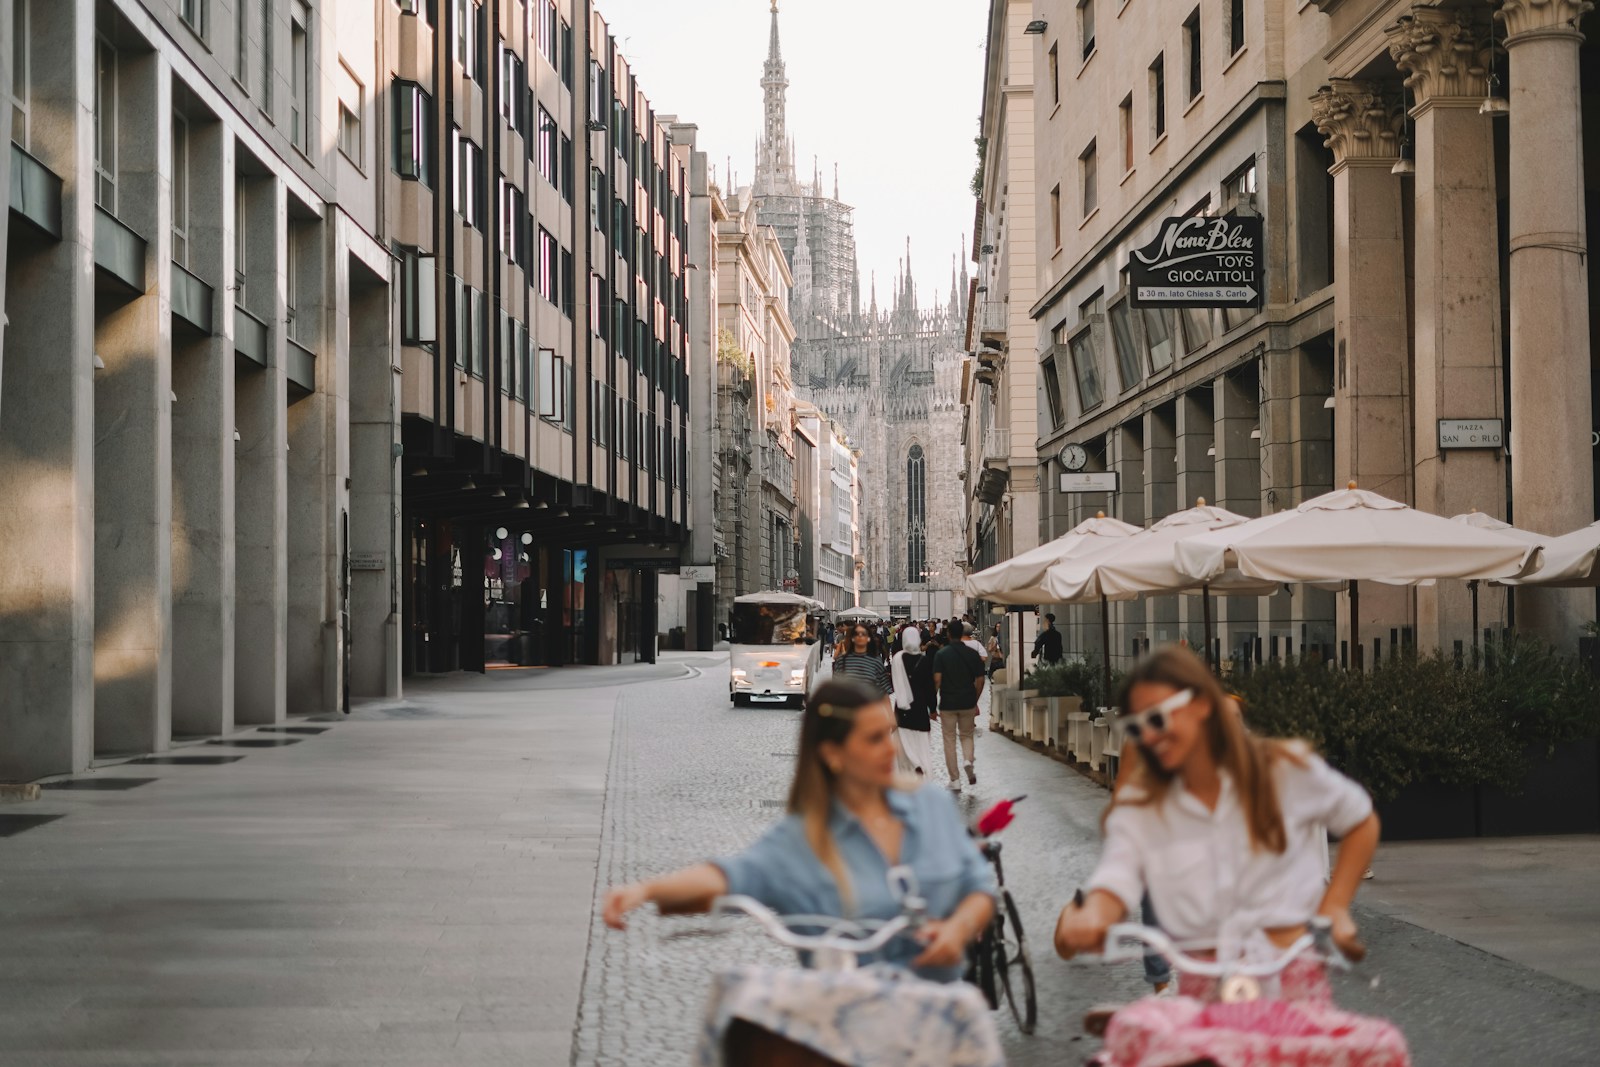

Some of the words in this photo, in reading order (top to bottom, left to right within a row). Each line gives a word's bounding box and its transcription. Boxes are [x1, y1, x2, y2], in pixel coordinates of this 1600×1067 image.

[1216, 255, 1254, 268] TOYS
[1167, 270, 1254, 283] GIOCATTOLI
[1442, 434, 1459, 443] SAN
